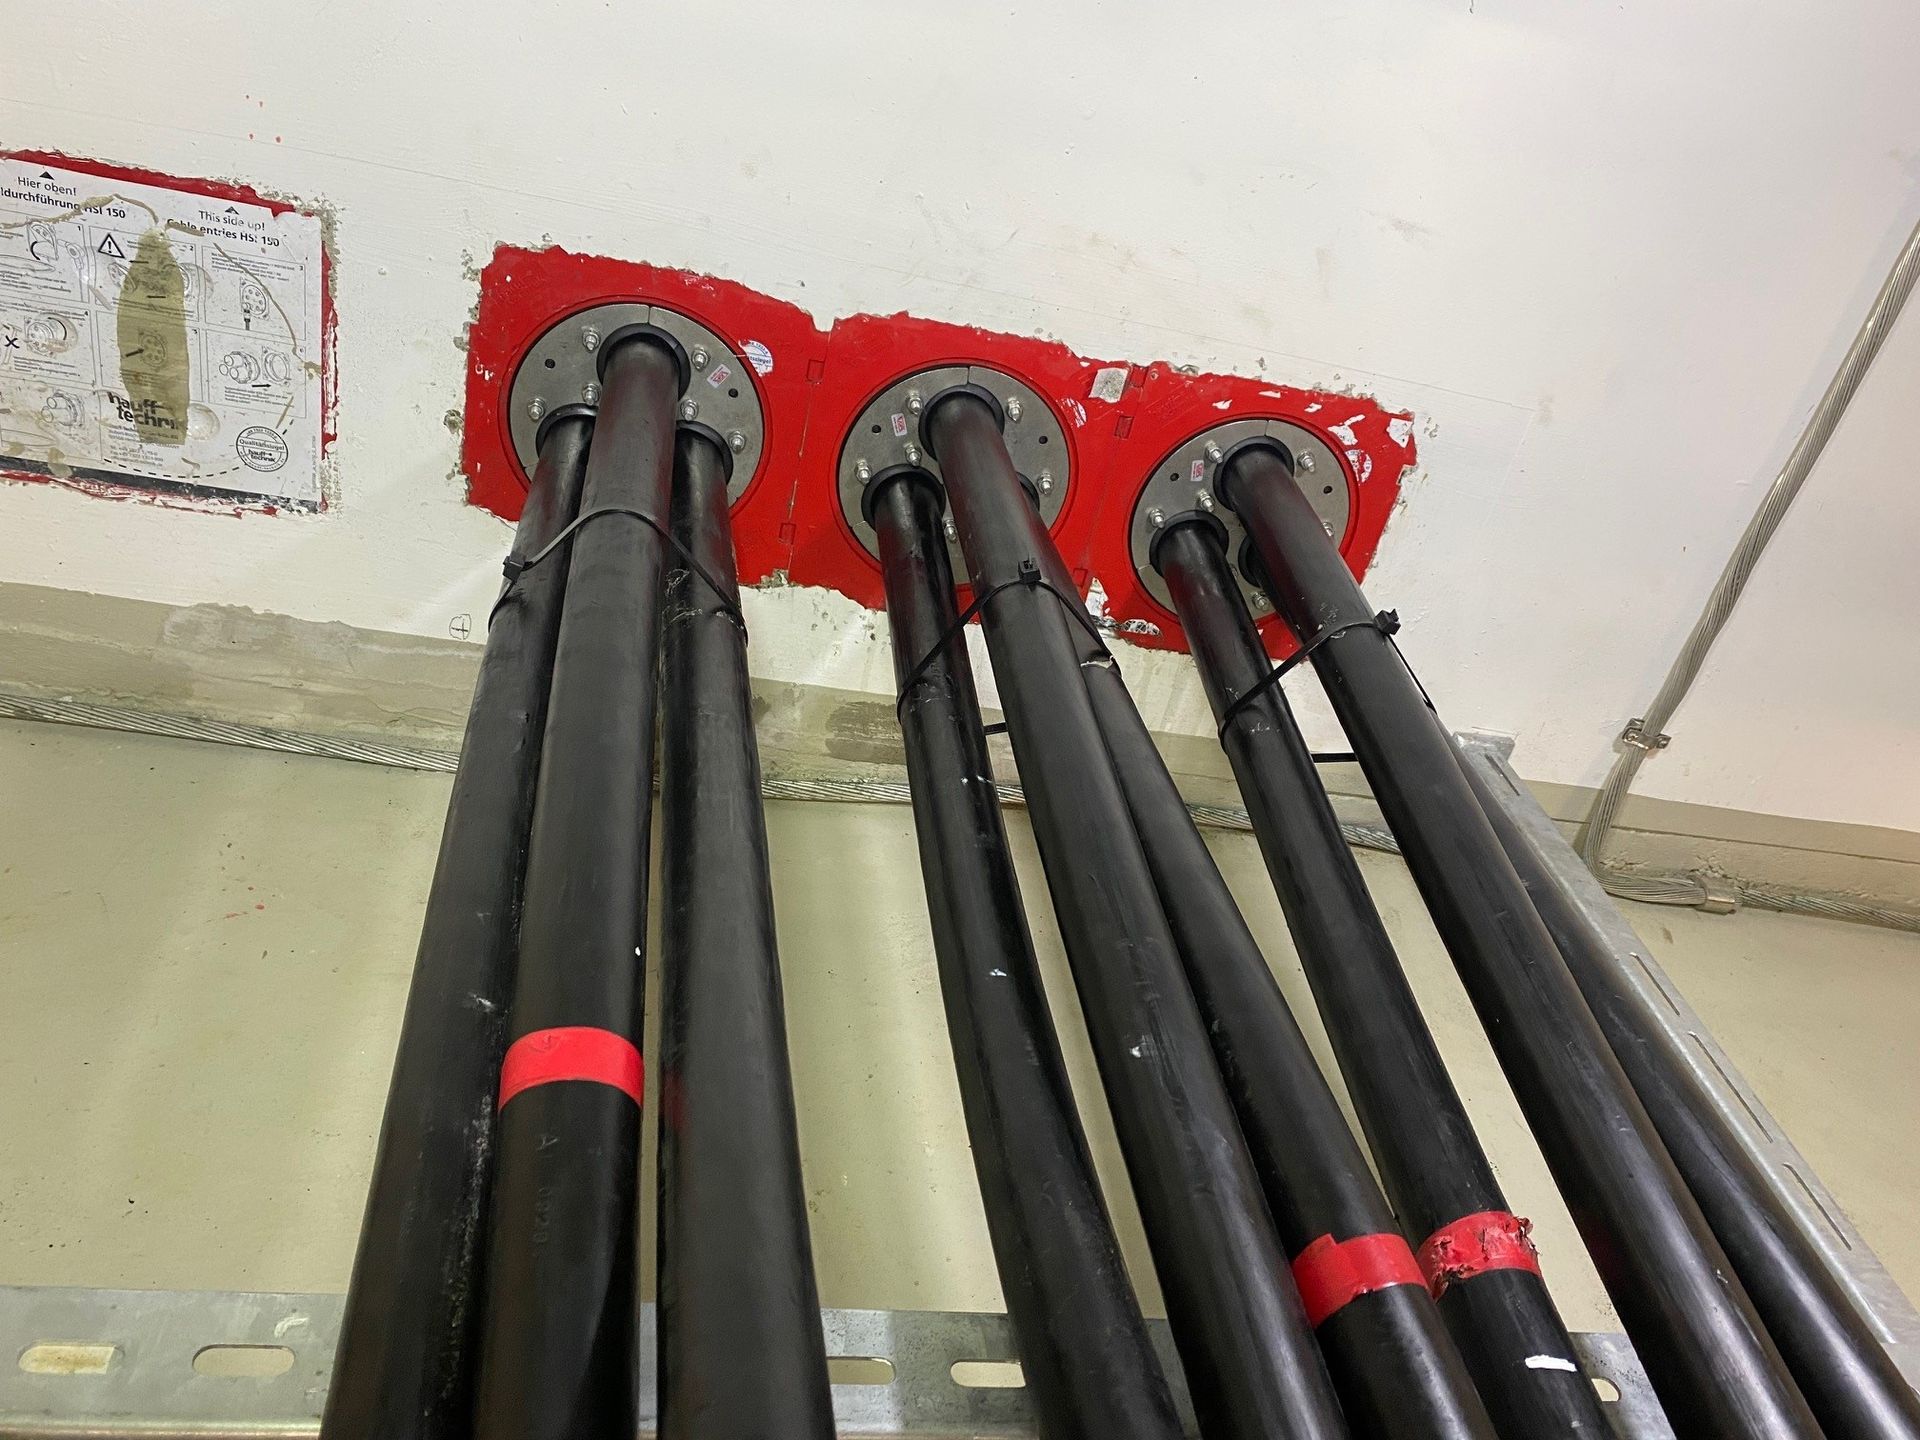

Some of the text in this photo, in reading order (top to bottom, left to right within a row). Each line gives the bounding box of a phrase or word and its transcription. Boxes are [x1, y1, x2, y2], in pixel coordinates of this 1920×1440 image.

[18, 176, 76, 196] Hier oben!
[106, 207, 126, 219] 150
[198, 210, 265, 232] This side up!
[199, 226, 237, 239] entries
[261, 235, 280, 247] 150
